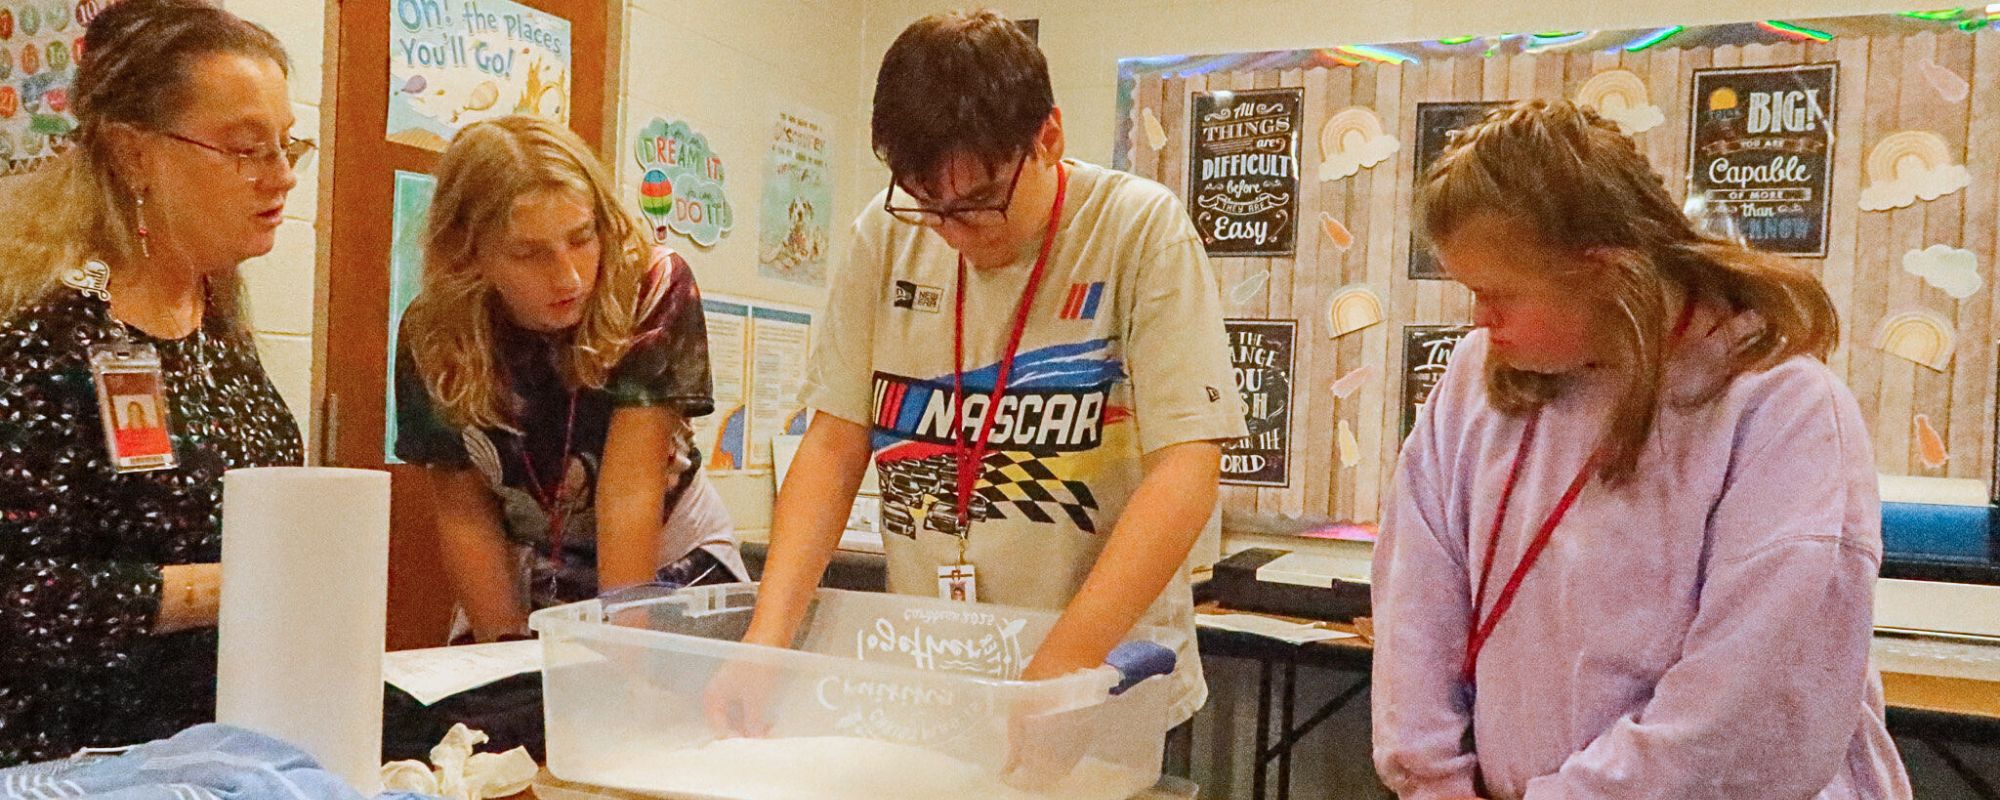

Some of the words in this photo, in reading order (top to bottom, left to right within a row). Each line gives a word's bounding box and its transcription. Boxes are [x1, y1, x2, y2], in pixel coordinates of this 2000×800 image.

[463, 2, 498, 33] the
[504, 15, 561, 54] Places
[400, 33, 465, 66] You'll
[474, 42, 514, 77] Go!
[1233, 102, 1255, 119] All
[1747, 89, 1819, 133] BIG!
[1202, 116, 1290, 141] THINGS
[643, 136, 704, 168] DREAM
[1256, 137, 1278, 149] are
[1202, 154, 1290, 180] DIFFICULT
[1709, 156, 1811, 188] Capable
[1226, 180, 1261, 198] before
[675, 197, 703, 223] DO
[706, 200, 727, 225] IT!
[1222, 203, 1244, 213] THEY
[1248, 202, 1265, 212] ARE
[1740, 203, 1775, 217] than
[1214, 216, 1268, 245] Easy
[1228, 345, 1278, 368] ANGE
[1232, 367, 1264, 392] OU
[916, 390, 1104, 445] NASCAR
[1239, 392, 1268, 420] SH
[1220, 454, 1266, 473] ORLD
